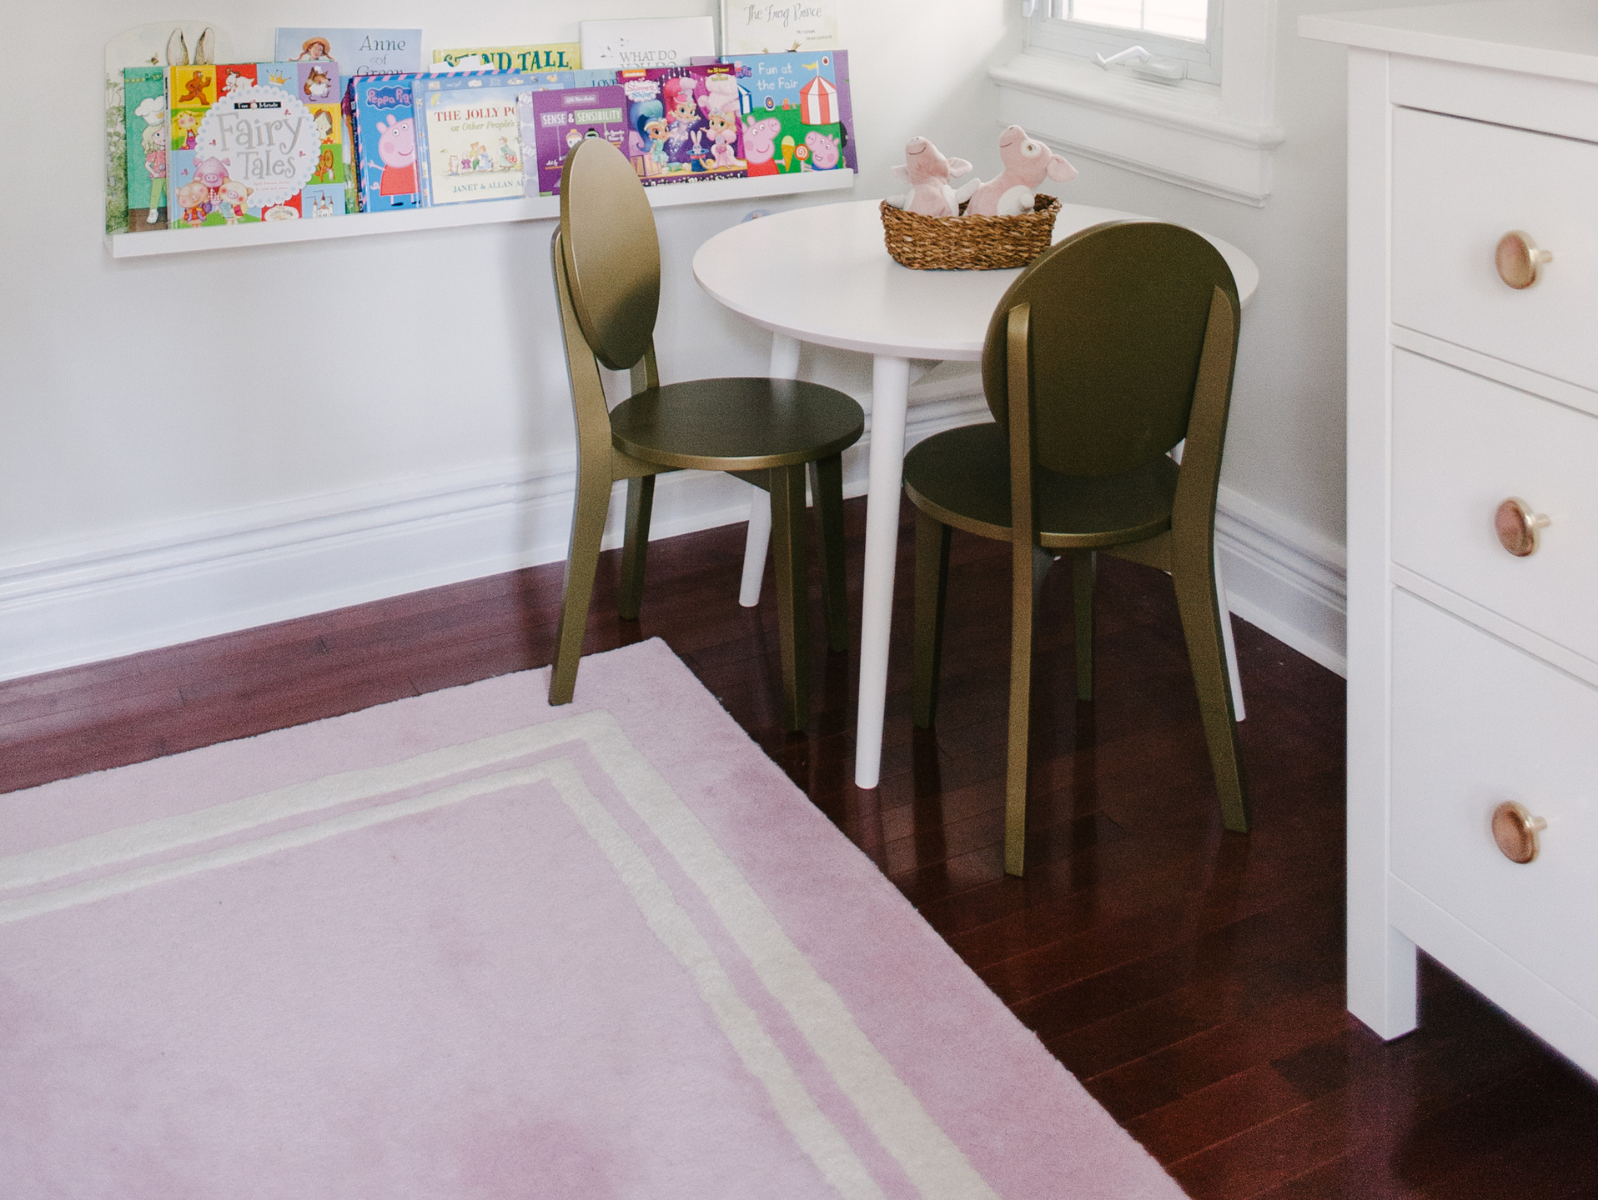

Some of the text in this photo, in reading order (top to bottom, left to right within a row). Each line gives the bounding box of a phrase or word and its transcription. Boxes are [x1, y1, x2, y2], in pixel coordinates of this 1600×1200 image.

[743, 2, 822, 28] The Frog Prince
[359, 35, 406, 51] Anne
[374, 53, 389, 65] of
[619, 49, 677, 62] WHAT DO
[758, 62, 778, 75] Fun
[781, 63, 792, 74] at
[757, 76, 798, 91] the Fair
[368, 89, 395, 107] Peppa
[434, 110, 461, 122] THE
[465, 107, 500, 121] JOLLY
[542, 109, 621, 125] SENSE & SENSIBILITY
[462, 121, 485, 131] Other
[486, 119, 515, 131] People's
[216, 111, 306, 155] Fairy
[236, 149, 297, 180] Tales
[453, 183, 478, 193] JANET
[487, 180, 514, 190] ALLAN
